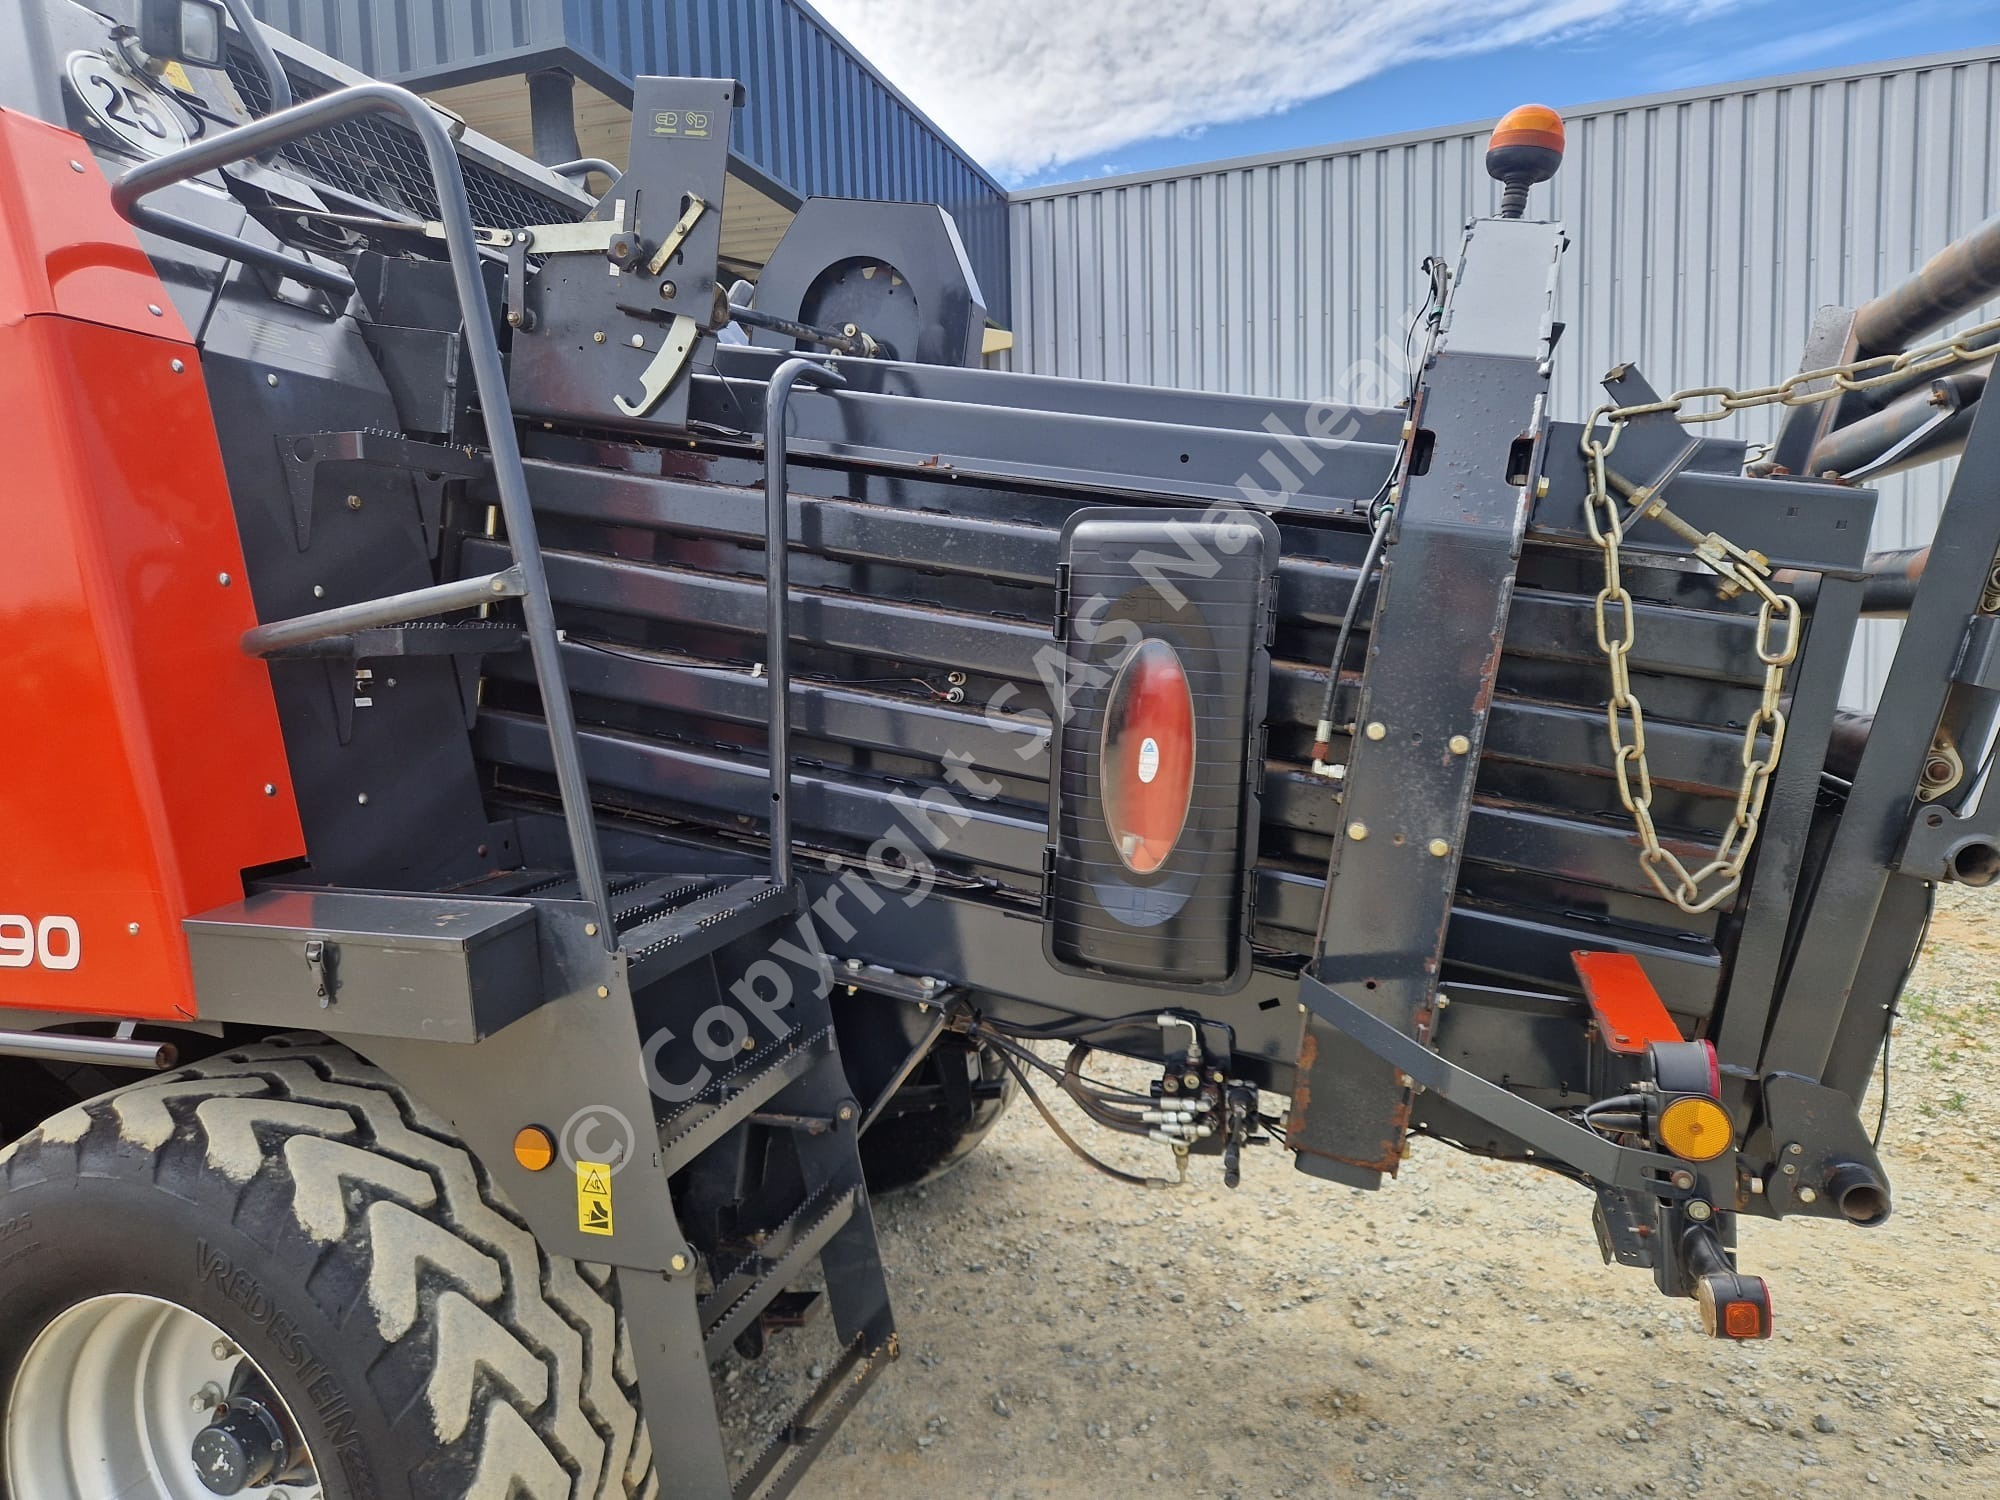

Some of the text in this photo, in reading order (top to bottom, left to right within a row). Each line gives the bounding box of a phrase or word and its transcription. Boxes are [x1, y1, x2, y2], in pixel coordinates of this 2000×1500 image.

[90, 74, 168, 139] 25
[0, 914, 81, 970] 90
[196, 1237, 361, 1452] VREDESTEIN
